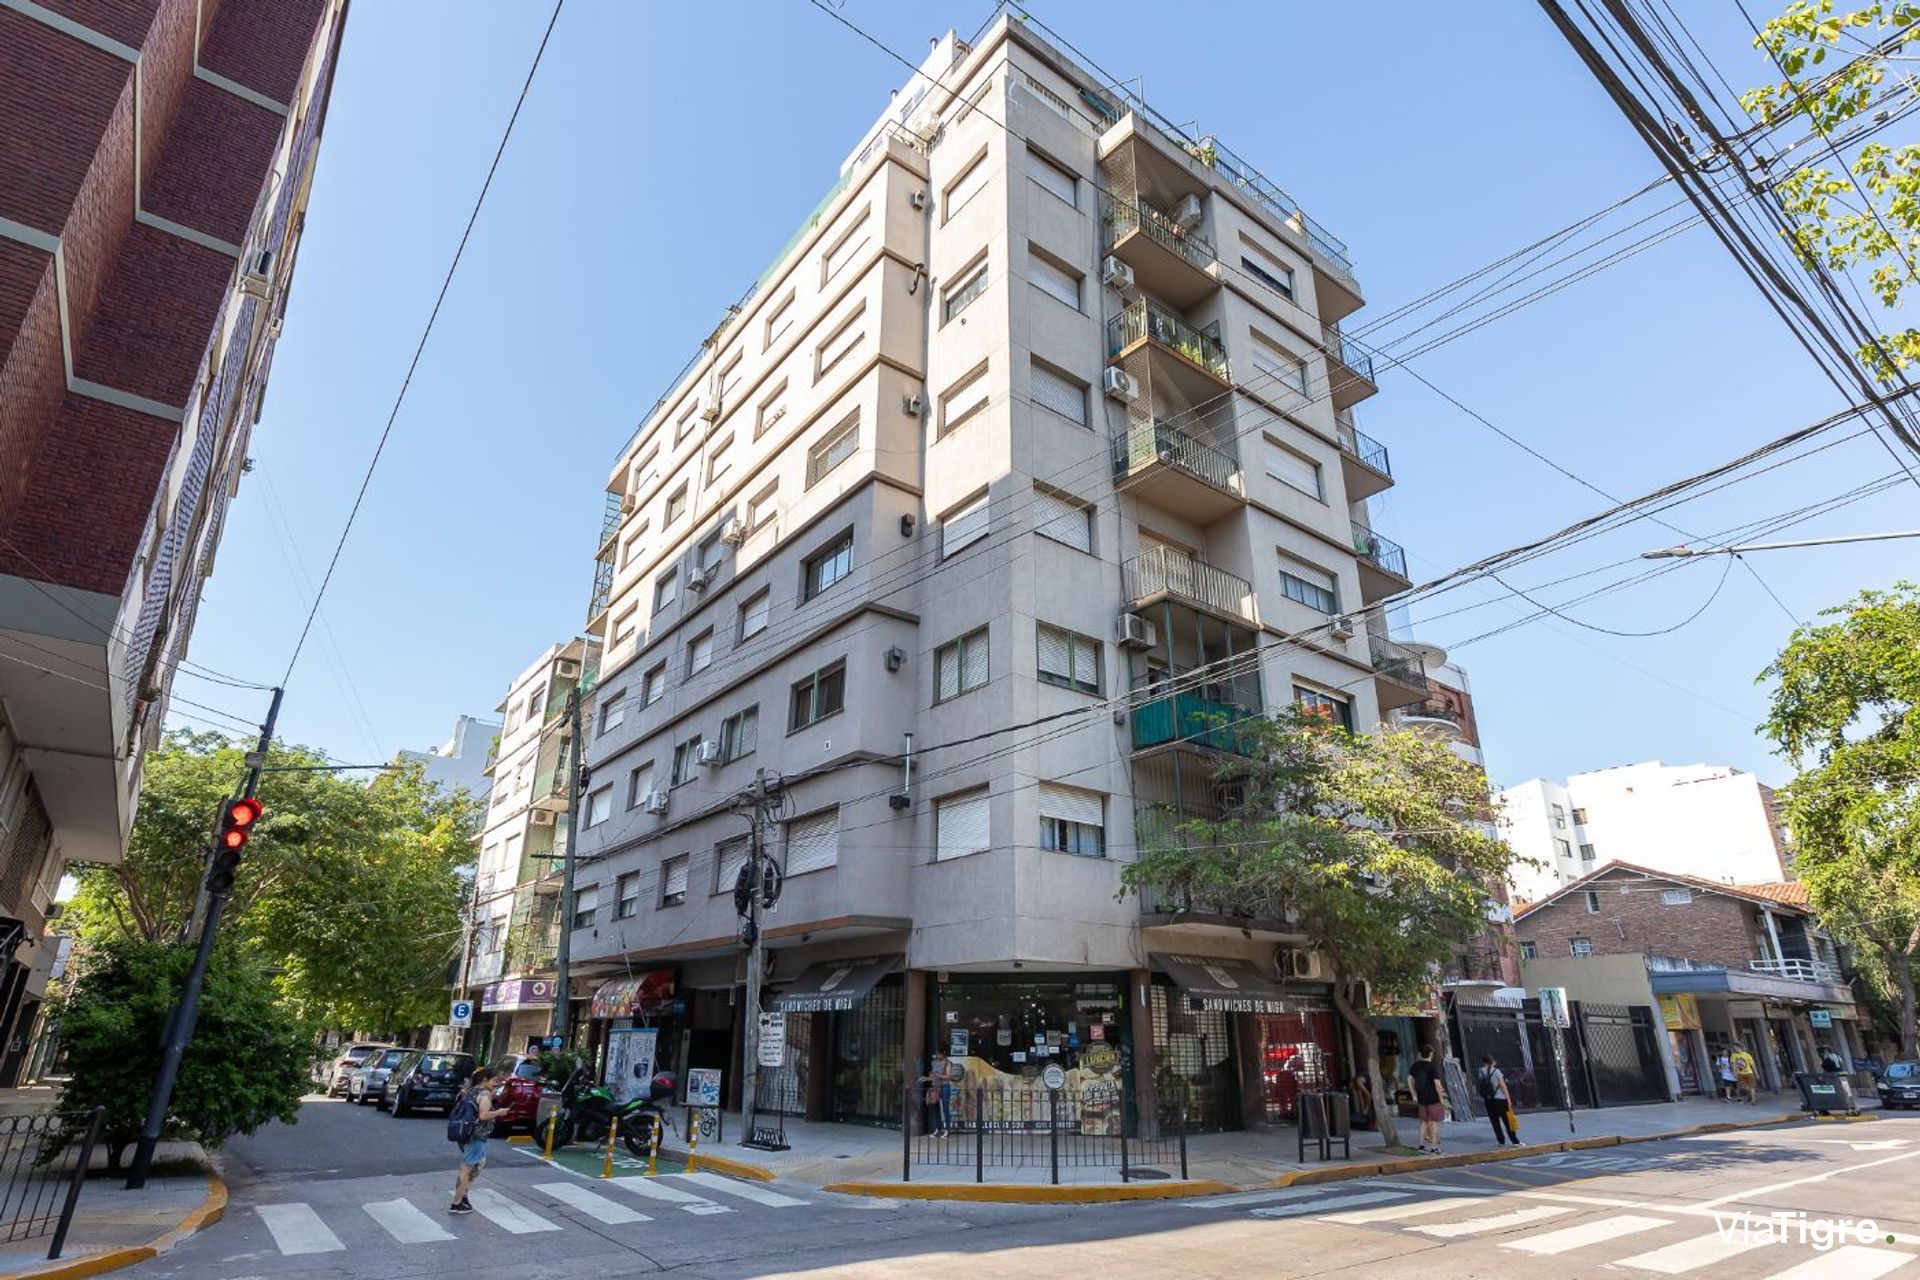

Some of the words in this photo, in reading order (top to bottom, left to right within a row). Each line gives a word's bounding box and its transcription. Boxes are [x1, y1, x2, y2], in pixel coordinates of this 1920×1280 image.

[824, 999, 833, 1010] DE
[1202, 998, 1252, 1012] SANDWICHES
[1254, 1000, 1264, 1013] DE
[1266, 1001, 1285, 1013] MIGA
